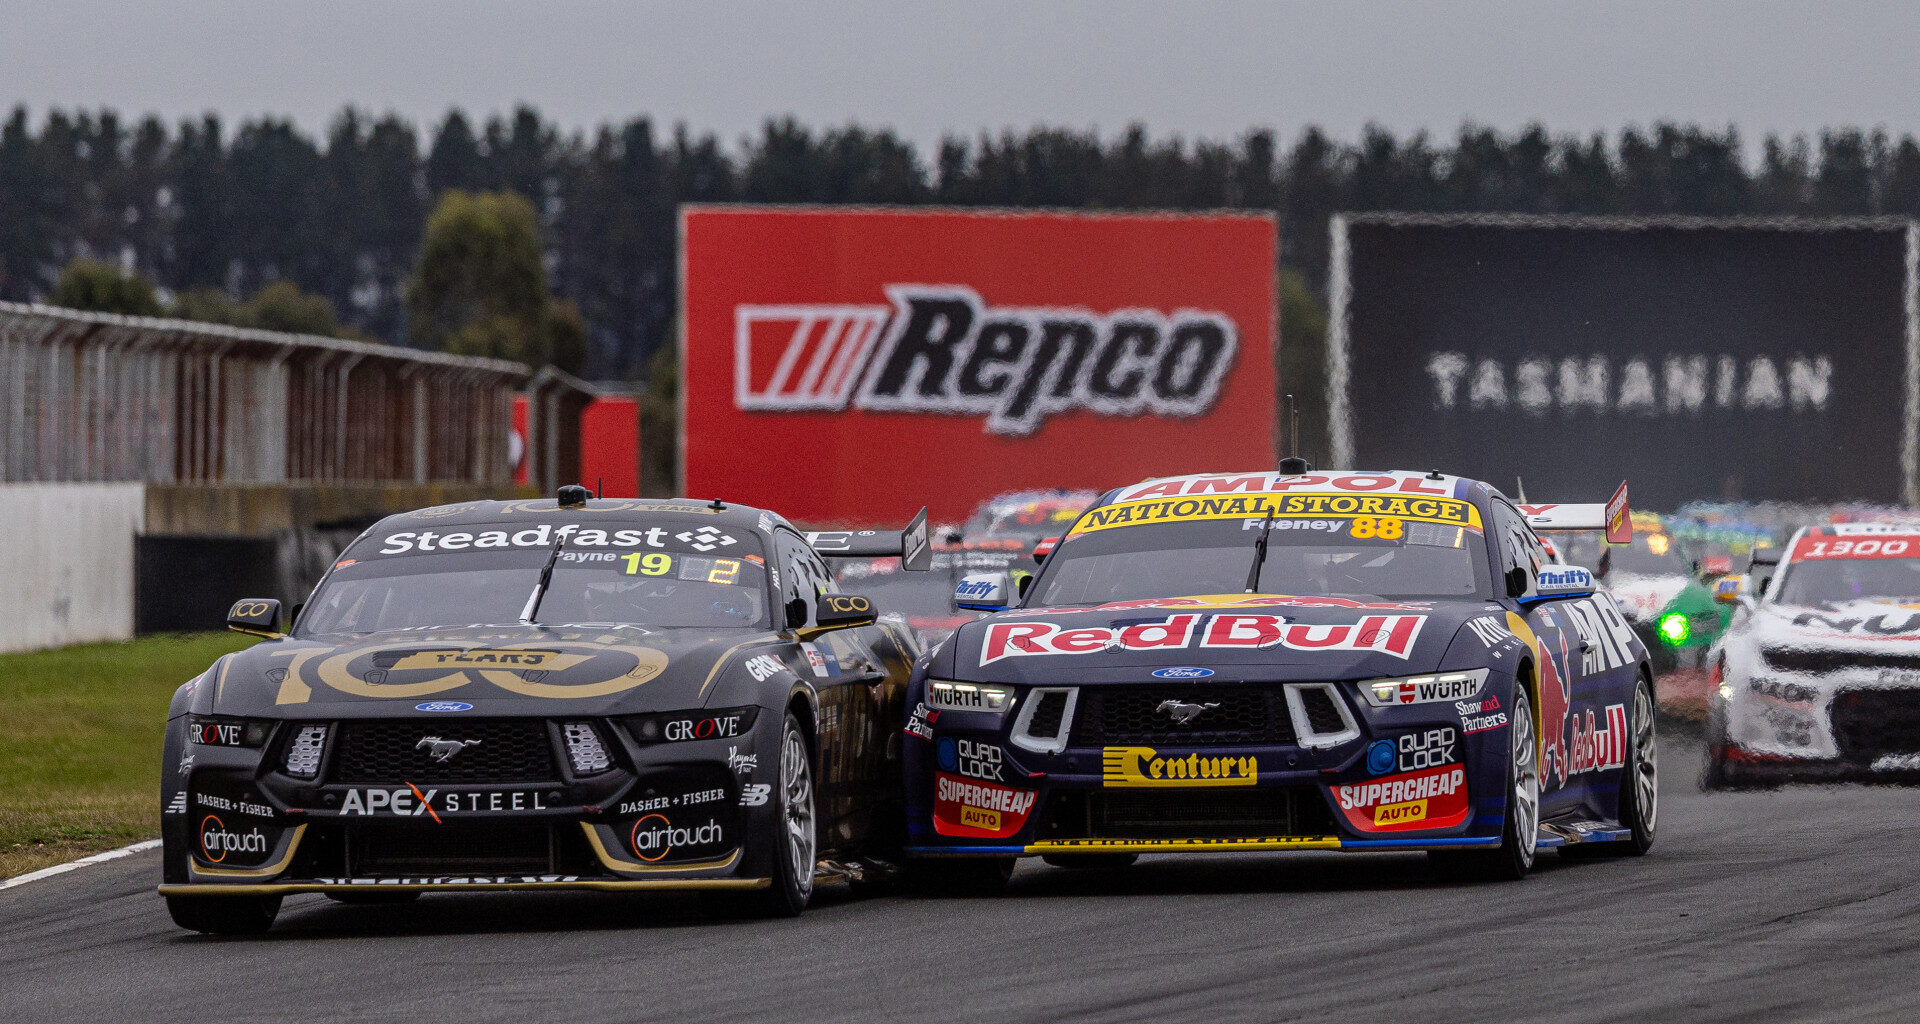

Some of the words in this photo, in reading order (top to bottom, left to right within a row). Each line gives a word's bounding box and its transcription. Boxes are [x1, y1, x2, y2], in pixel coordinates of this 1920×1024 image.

[866, 293, 1233, 424] Repco
[1428, 352, 1833, 411] TASMANIAN
[1123, 475, 1447, 500] AMPOL
[1083, 496, 1278, 529] NATIONAL
[1286, 496, 1462, 520] STORAGE
[380, 525, 668, 554] Steadfast
[1242, 518, 1345, 532] Feeney
[1350, 517, 1403, 540] 88
[1804, 540, 1909, 556] 1300
[620, 553, 672, 576] 19
[708, 559, 740, 584] 2
[956, 581, 998, 599] Thrifty
[1538, 570, 1590, 587] Thrifty
[231, 602, 269, 618] 100
[826, 597, 870, 612] 100
[980, 616, 1192, 666] Red
[1201, 614, 1427, 660] Bull
[436, 651, 546, 666] YEARS
[1164, 667, 1203, 679] Ford
[934, 690, 982, 707] WÜRTH
[1420, 678, 1477, 700] WÜRTH
[426, 701, 461, 712] Ford
[190, 723, 241, 745] GROVE
[665, 716, 738, 741] GROVE
[1460, 712, 1508, 733] Partners
[958, 738, 1003, 763] QUAD
[1399, 727, 1456, 753] QUAD
[1587, 704, 1628, 772] Bull
[958, 757, 1005, 782] LOCK
[1122, 747, 1258, 787] Century
[1399, 744, 1456, 772] LOCK
[619, 796, 670, 814] DASHER
[683, 788, 725, 805] FISHER
[938, 777, 1035, 815] SUPERCHEAP
[1340, 769, 1464, 810] SUPERCHEAP
[197, 793, 231, 811] DASHER
[240, 801, 275, 818] FISHER
[339, 784, 442, 822] APEX
[446, 792, 547, 812] STEEL
[1380, 805, 1422, 821] AUTO
[964, 811, 997, 826] AUTO
[203, 827, 266, 852] airtouch
[636, 818, 722, 850] airtouch
